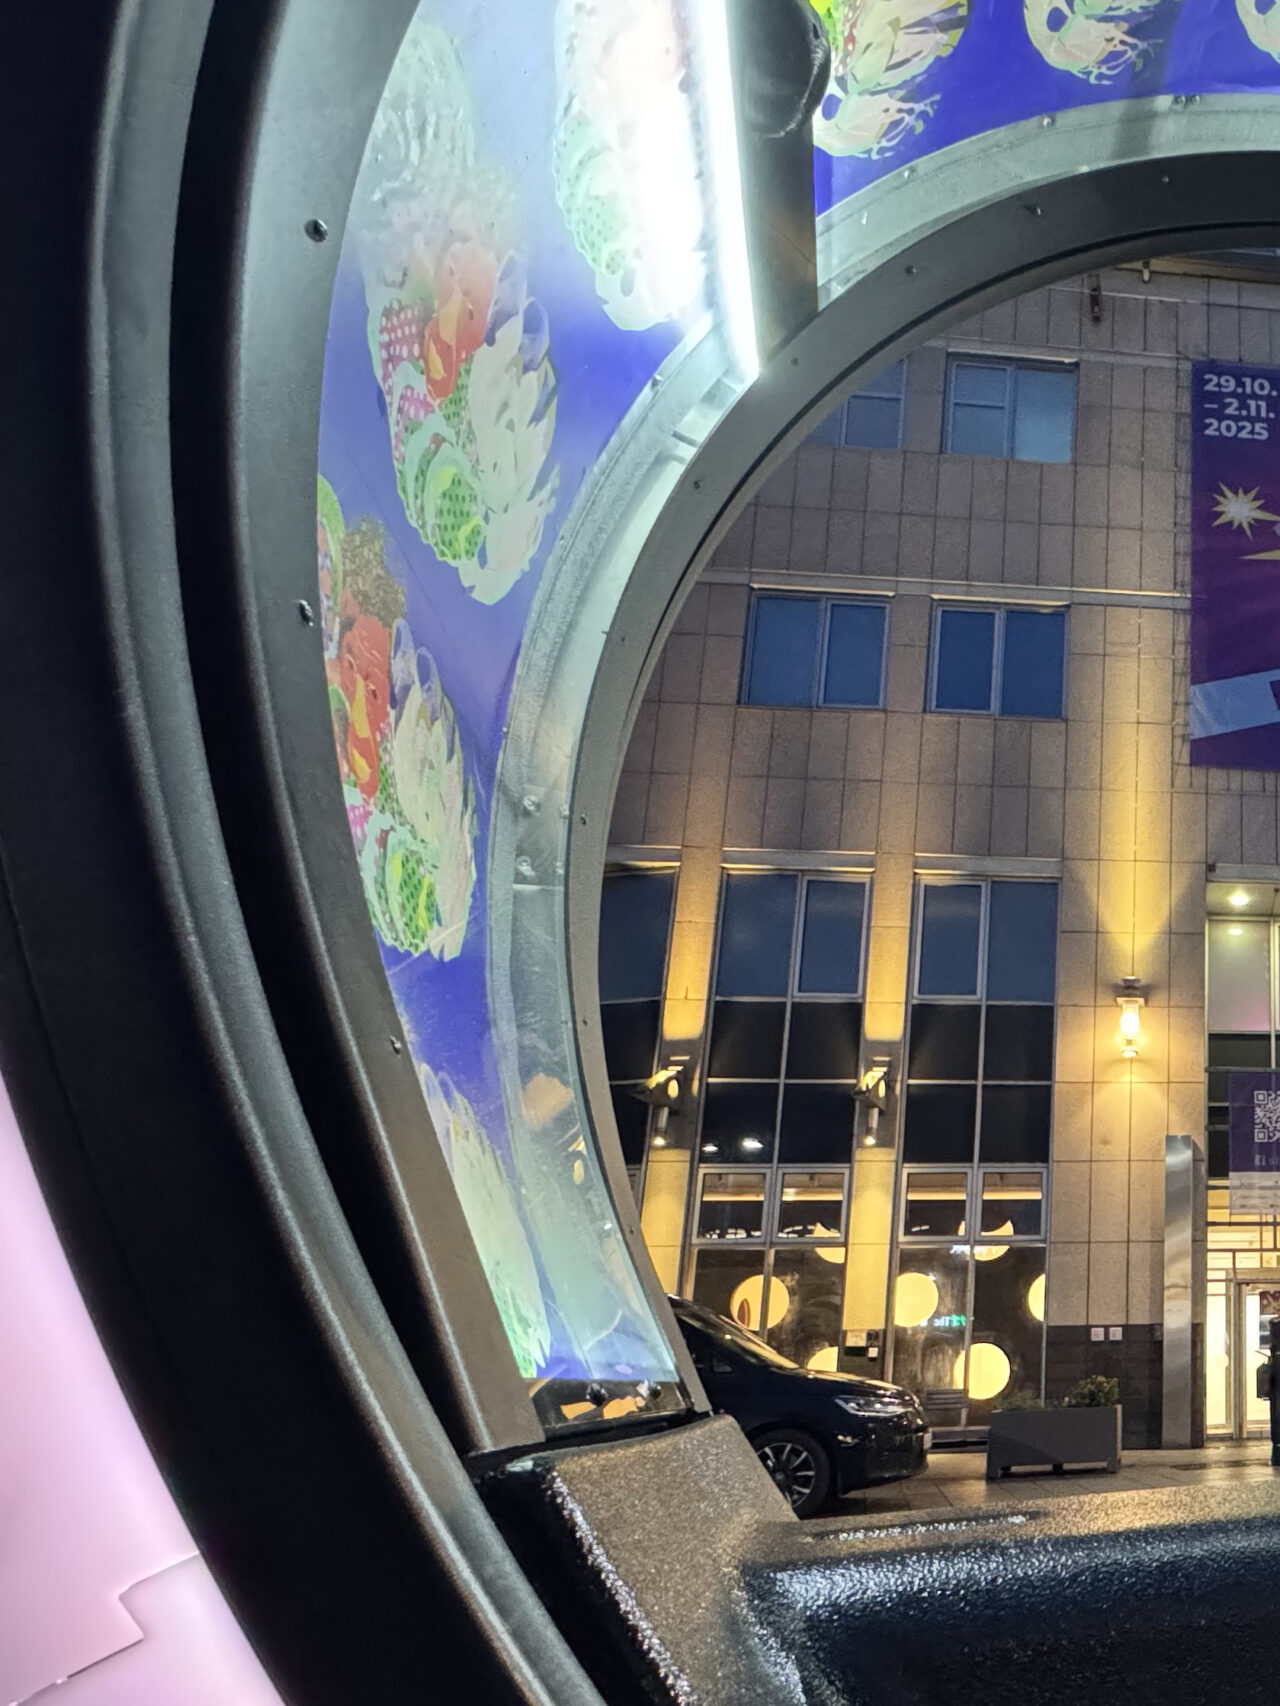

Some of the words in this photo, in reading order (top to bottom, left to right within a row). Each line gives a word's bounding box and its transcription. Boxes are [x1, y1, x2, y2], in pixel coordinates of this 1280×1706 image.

[1203, 373, 1278, 397] 29.10.
[1223, 398, 1276, 418] 2.11.
[1203, 418, 1270, 441] 2025
